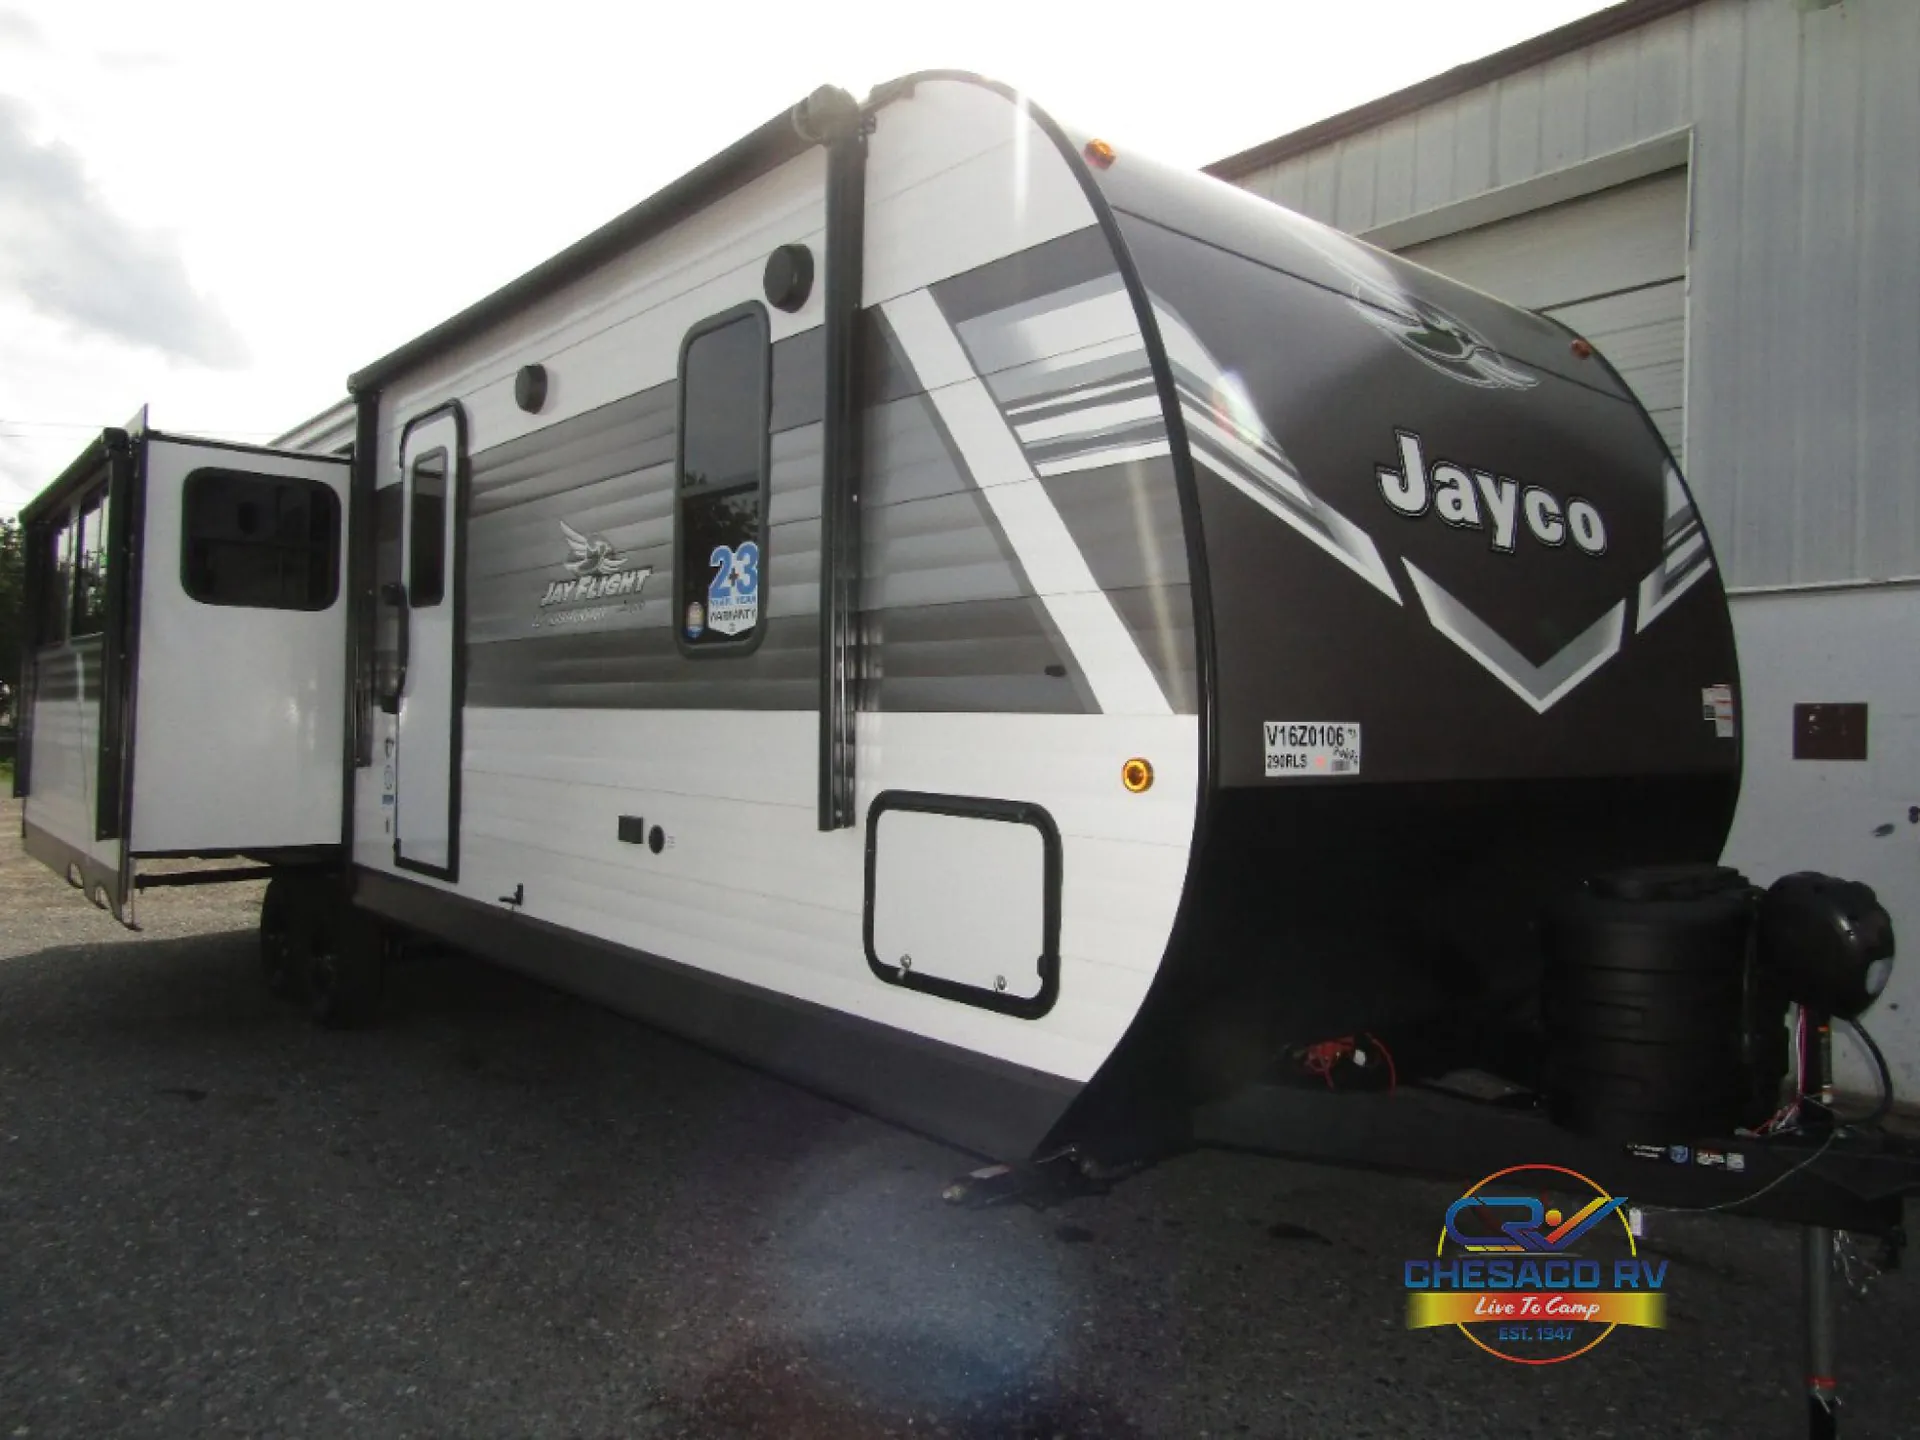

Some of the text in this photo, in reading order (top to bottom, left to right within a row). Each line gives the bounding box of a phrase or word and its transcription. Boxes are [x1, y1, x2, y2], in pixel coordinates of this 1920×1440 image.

[1374, 428, 1607, 556] Jayco
[540, 567, 652, 607] JAY FLIGHT
[1265, 725, 1345, 747] V16Z0106
[1267, 754, 1308, 769] 290RLS
